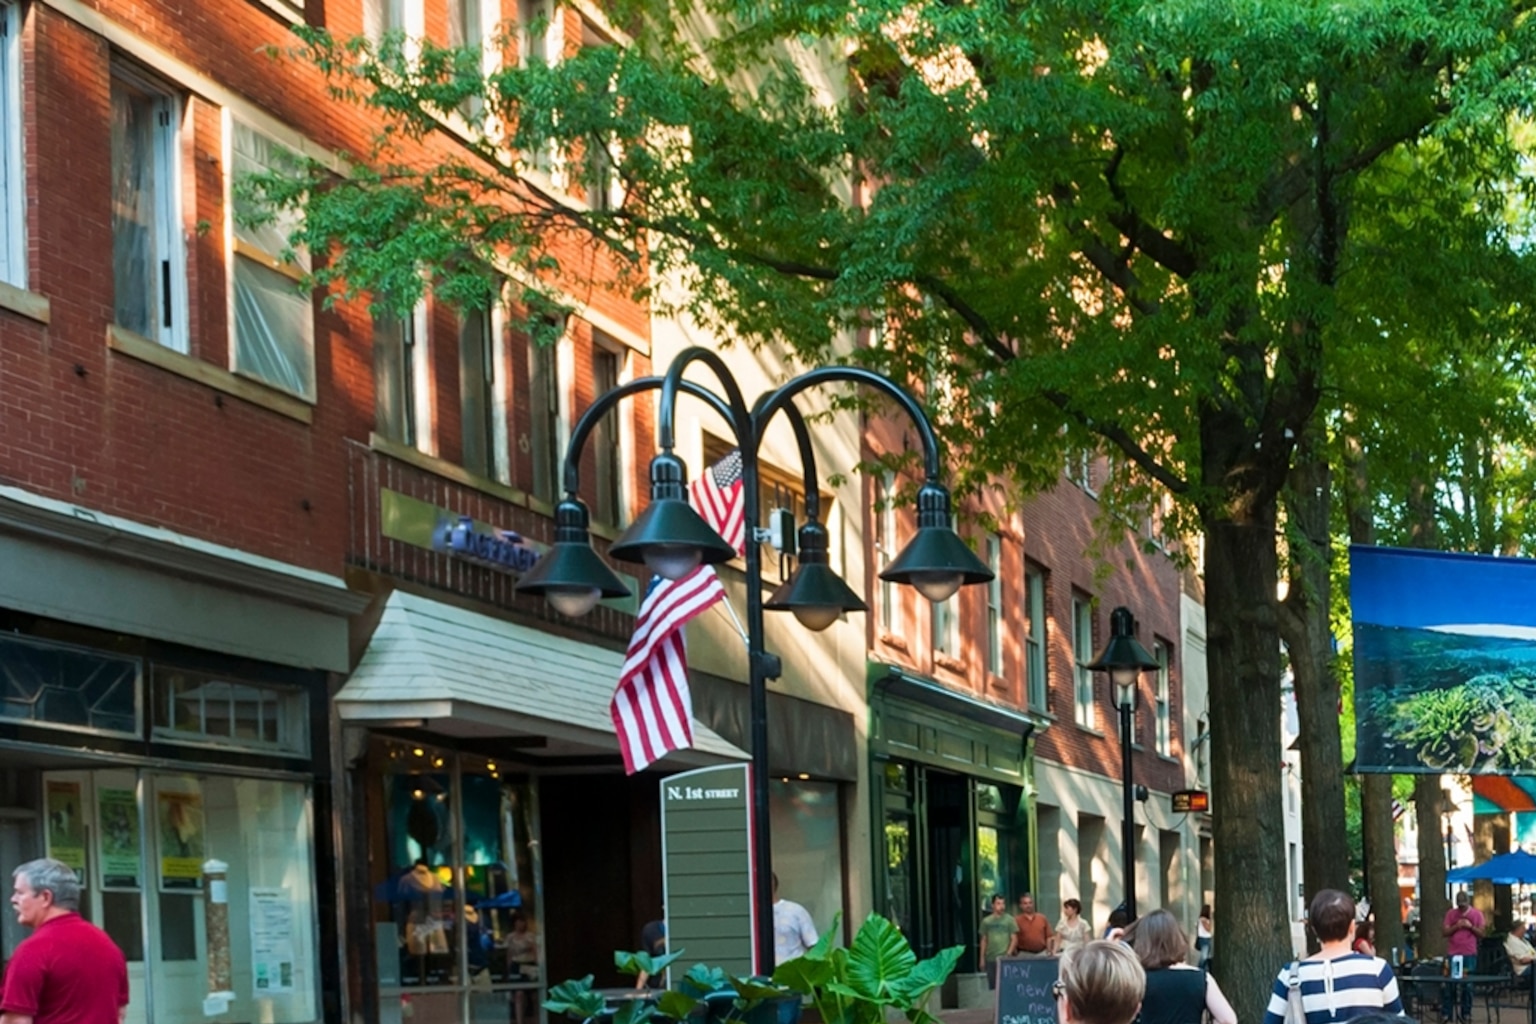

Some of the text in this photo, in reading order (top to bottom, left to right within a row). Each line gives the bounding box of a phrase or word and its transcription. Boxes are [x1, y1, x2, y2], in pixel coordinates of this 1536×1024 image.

[667, 786, 739, 800] N. 1st STREET
[1003, 964, 1032, 979] new
[1016, 981, 1050, 998] new
[1028, 1002, 1056, 1016] new
